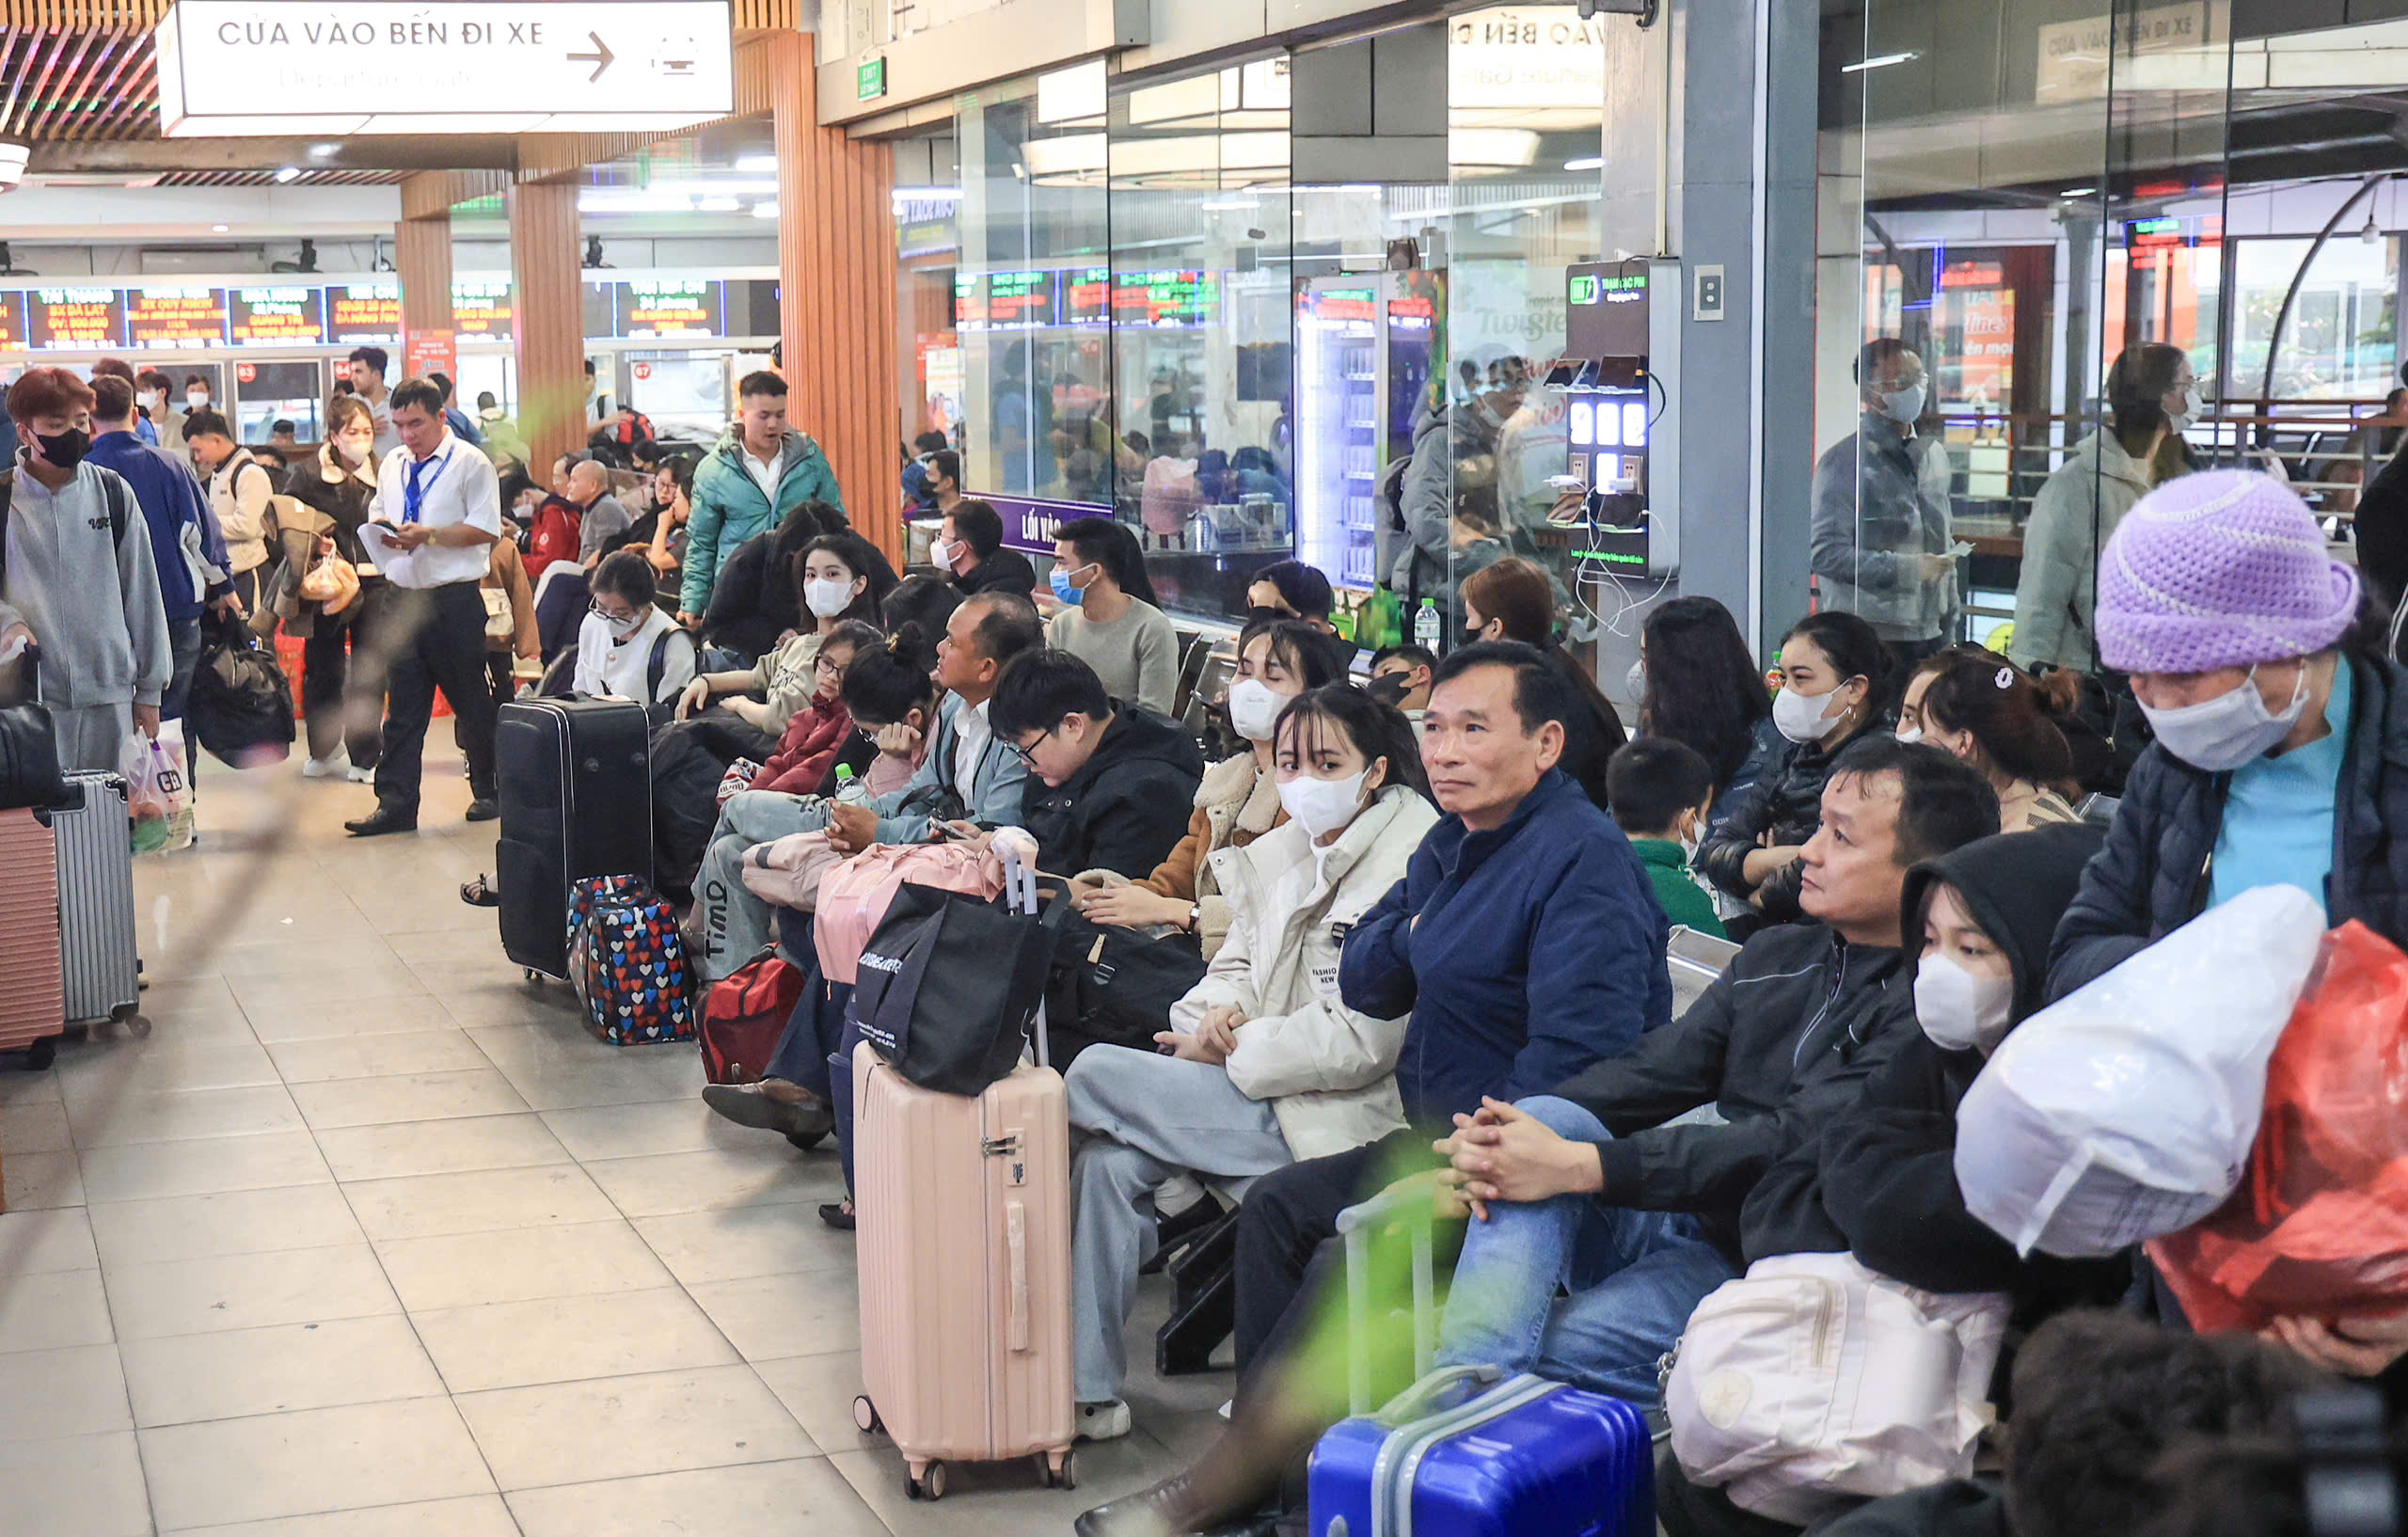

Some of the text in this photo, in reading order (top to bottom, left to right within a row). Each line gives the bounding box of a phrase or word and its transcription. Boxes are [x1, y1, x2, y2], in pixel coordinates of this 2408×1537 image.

[304, 13, 375, 45] VÀO
[390, 10, 448, 45] BẾN
[462, 22, 493, 45] ĐI
[508, 22, 543, 45] XE
[1022, 507, 1038, 542] LỐI
[1321, 975, 1335, 984] NEW
